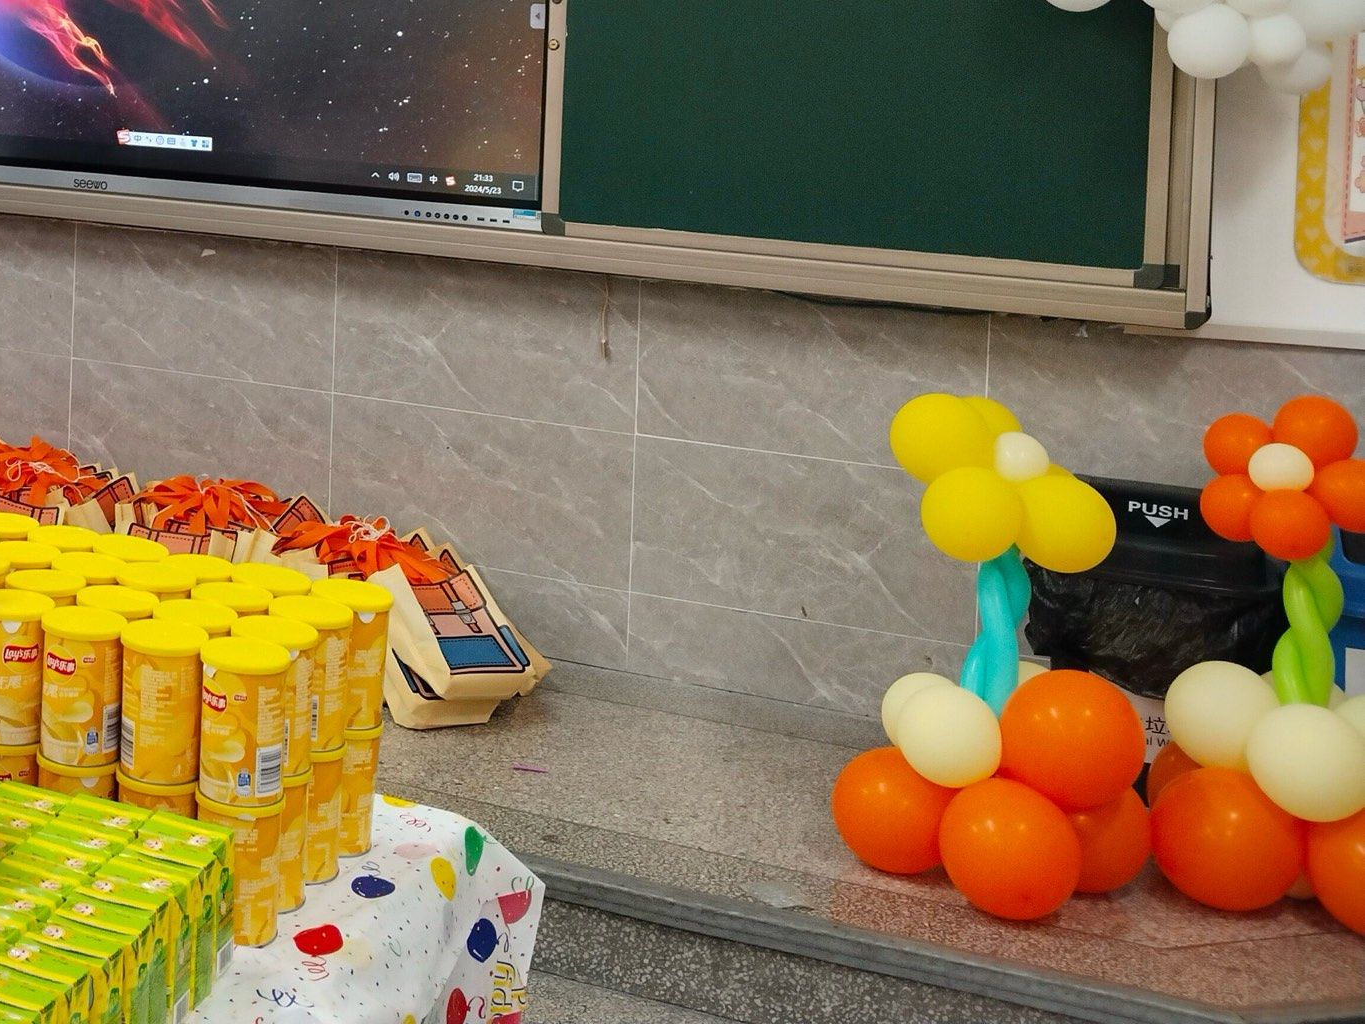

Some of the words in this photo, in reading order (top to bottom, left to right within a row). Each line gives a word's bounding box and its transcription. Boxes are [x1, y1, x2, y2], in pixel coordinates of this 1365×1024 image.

[73, 178, 108, 191] seewo
[473, 174, 494, 183] 21:33
[464, 184, 502, 195] 2024/5/23
[1128, 501, 1189, 521] PUSH
